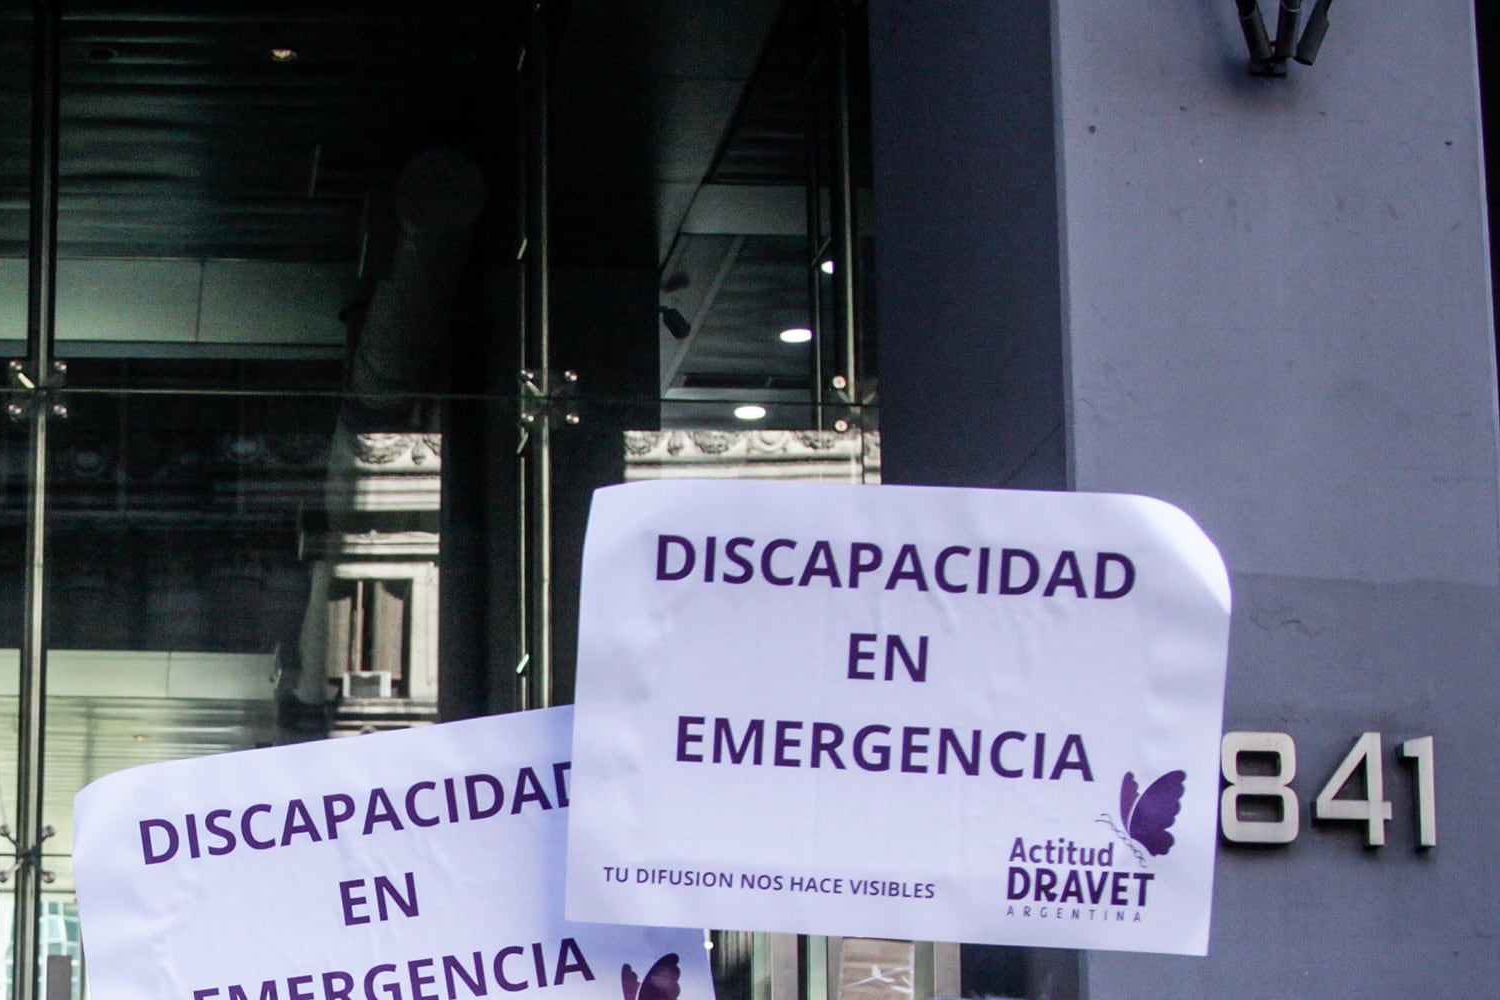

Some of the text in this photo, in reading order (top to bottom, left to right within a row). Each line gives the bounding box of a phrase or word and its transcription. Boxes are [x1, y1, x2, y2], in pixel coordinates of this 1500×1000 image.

[654, 533, 1137, 601] DISCAPACIDAD
[847, 632, 930, 683] EN
[675, 714, 1095, 782] EMERGENCIA
[1220, 731, 1437, 846] 841
[1008, 836, 1115, 868] Actitud
[338, 871, 420, 927] EN
[603, 866, 936, 900] TU DIFUSION NOS HACE VISIBLES
[1006, 866, 1156, 908] DRAVET
[1006, 905, 1143, 923] ARGENTINA
